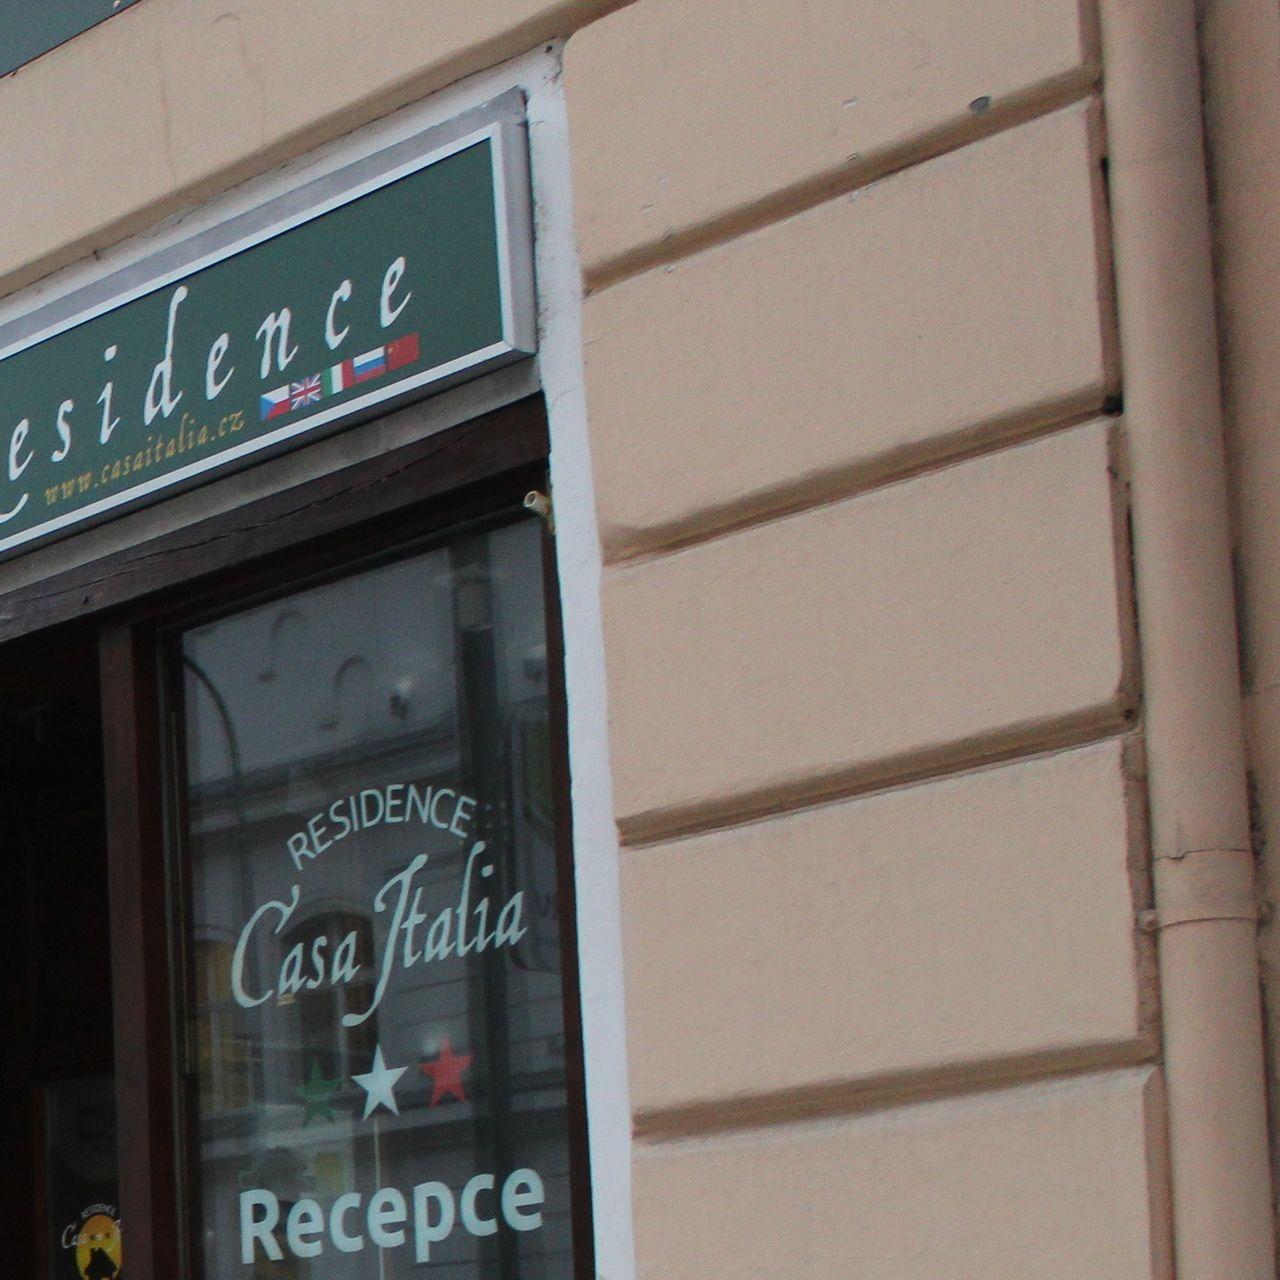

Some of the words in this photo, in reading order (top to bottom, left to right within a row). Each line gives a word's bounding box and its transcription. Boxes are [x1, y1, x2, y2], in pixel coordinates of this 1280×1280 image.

[43, 408, 245, 508] www.casaitalia.cz
[285, 783, 478, 871] RESIDENCE
[231, 884, 363, 1009] Casa
[341, 839, 529, 1028] Italia
[240, 1167, 546, 1265] Recepce
